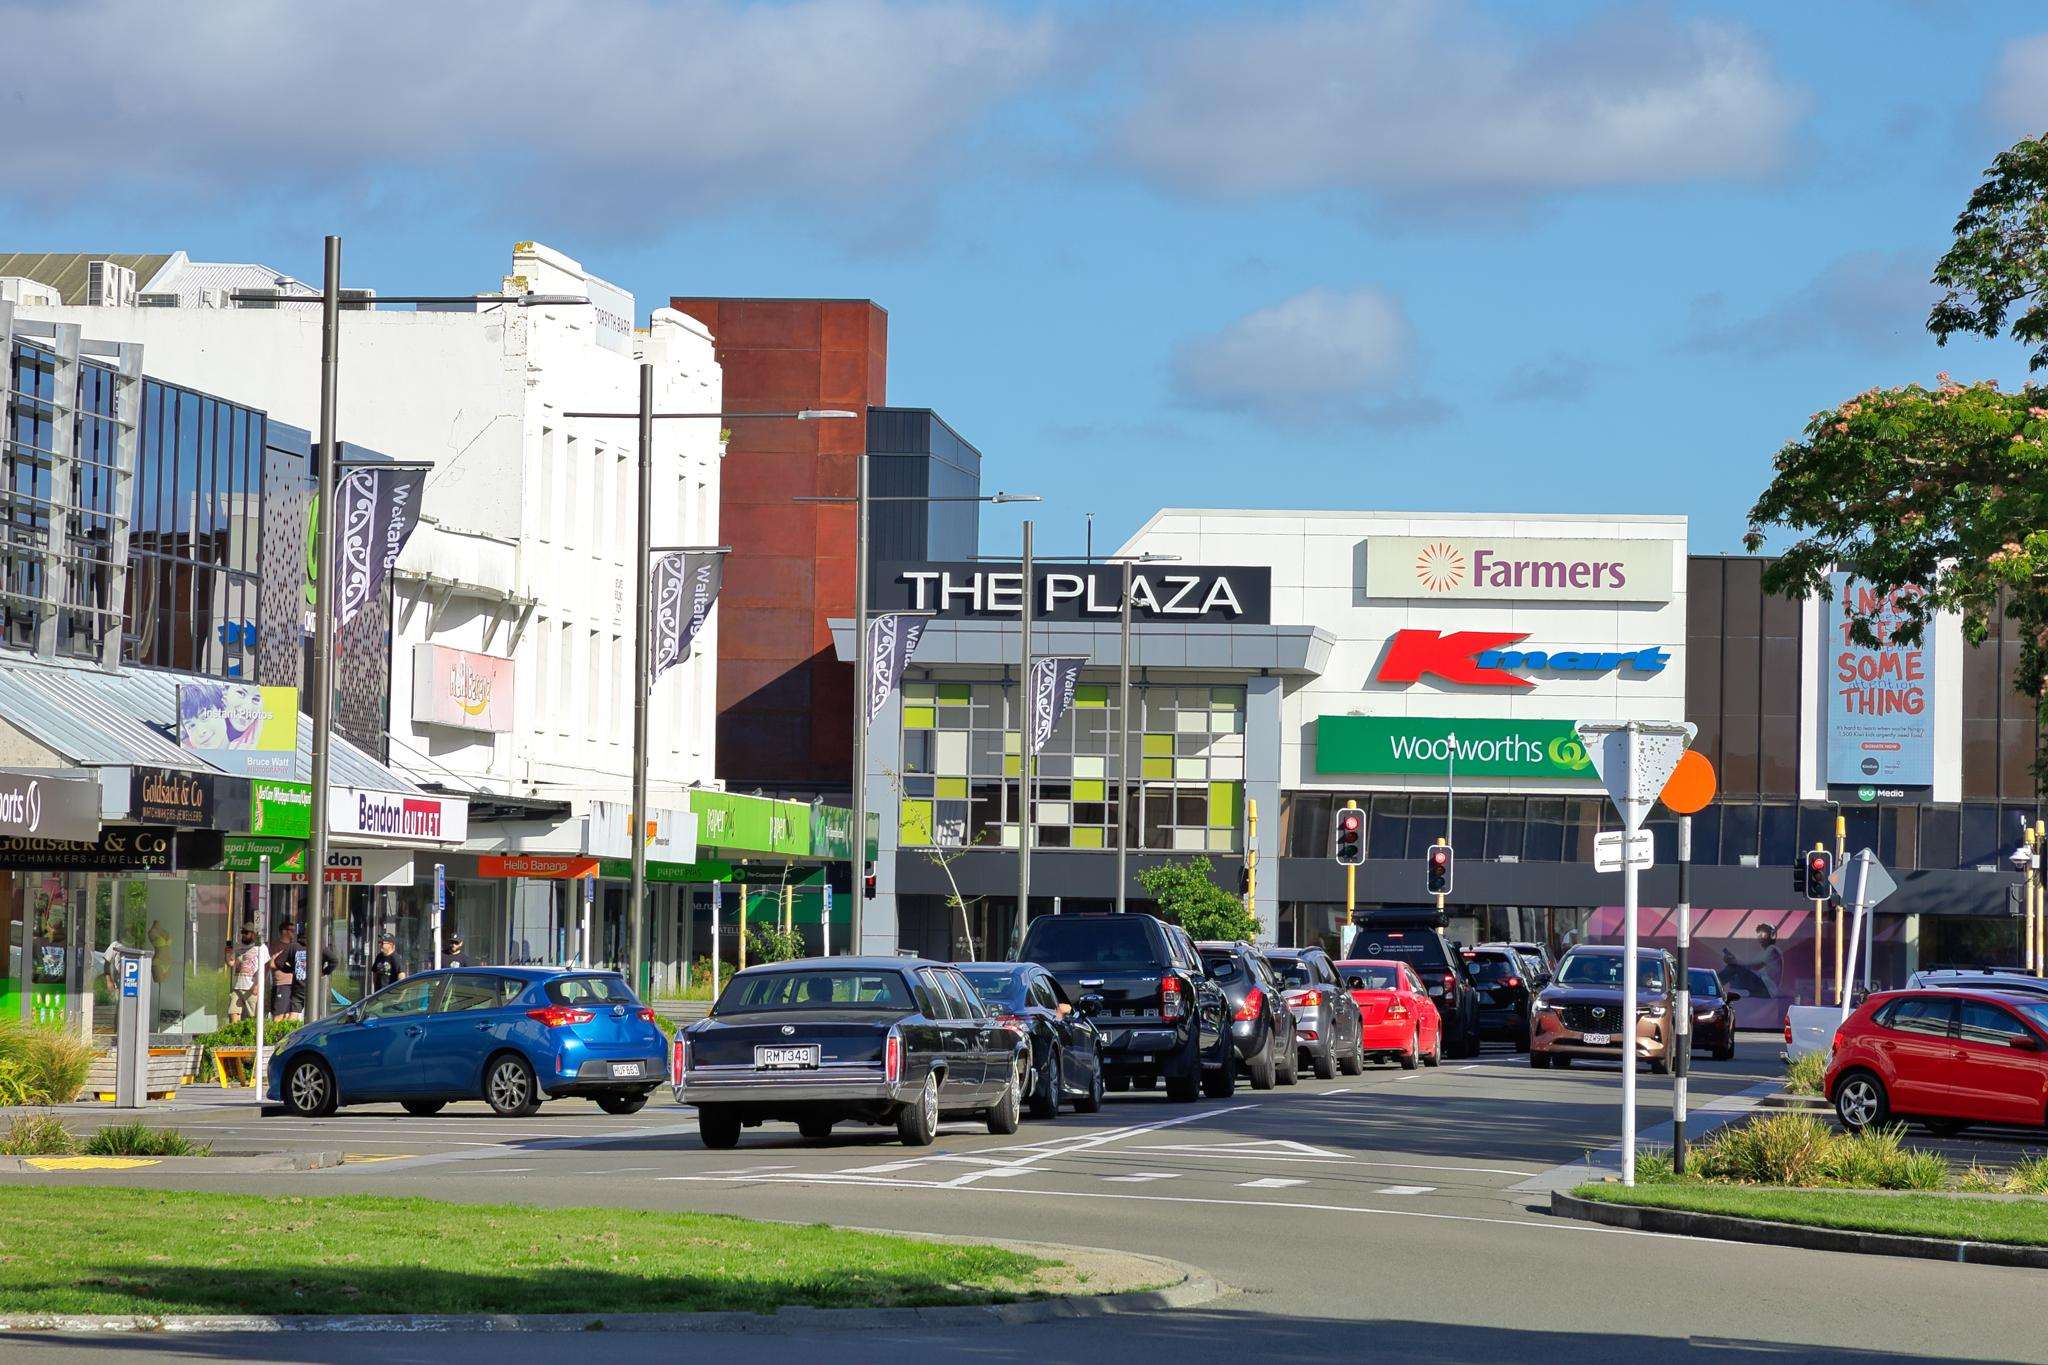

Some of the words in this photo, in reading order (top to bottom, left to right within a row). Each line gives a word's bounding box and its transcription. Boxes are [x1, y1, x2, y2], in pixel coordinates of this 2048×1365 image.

[384, 484, 411, 568] Waitang
[1473, 550, 1626, 590] Farmers
[690, 564, 712, 636] Waitang
[902, 571, 1023, 612] THE
[1046, 573, 1243, 615] PLAZA
[1376, 629, 1672, 688] Kmart
[1838, 652, 1925, 683] SOME
[204, 708, 237, 719] Instant
[241, 709, 273, 720] Photos
[1839, 687, 1925, 716] THING
[247, 757, 270, 766] Bruce
[272, 757, 289, 766] Watt
[1390, 734, 1543, 764] Wooworths
[143, 775, 179, 804] Goldsack
[181, 781, 189, 805] &
[191, 781, 203, 807] Co
[1877, 789, 1904, 797] Media
[358, 793, 400, 833] Bendon
[404, 810, 440, 836] OUTLET
[104, 833, 126, 852] &
[135, 833, 166, 852] Co
[230, 855, 252, 865] Trust
[503, 860, 528, 870] Hello
[531, 861, 568, 872] Banana
[125, 962, 138, 977] P
[766, 1050, 809, 1061] RMT343
